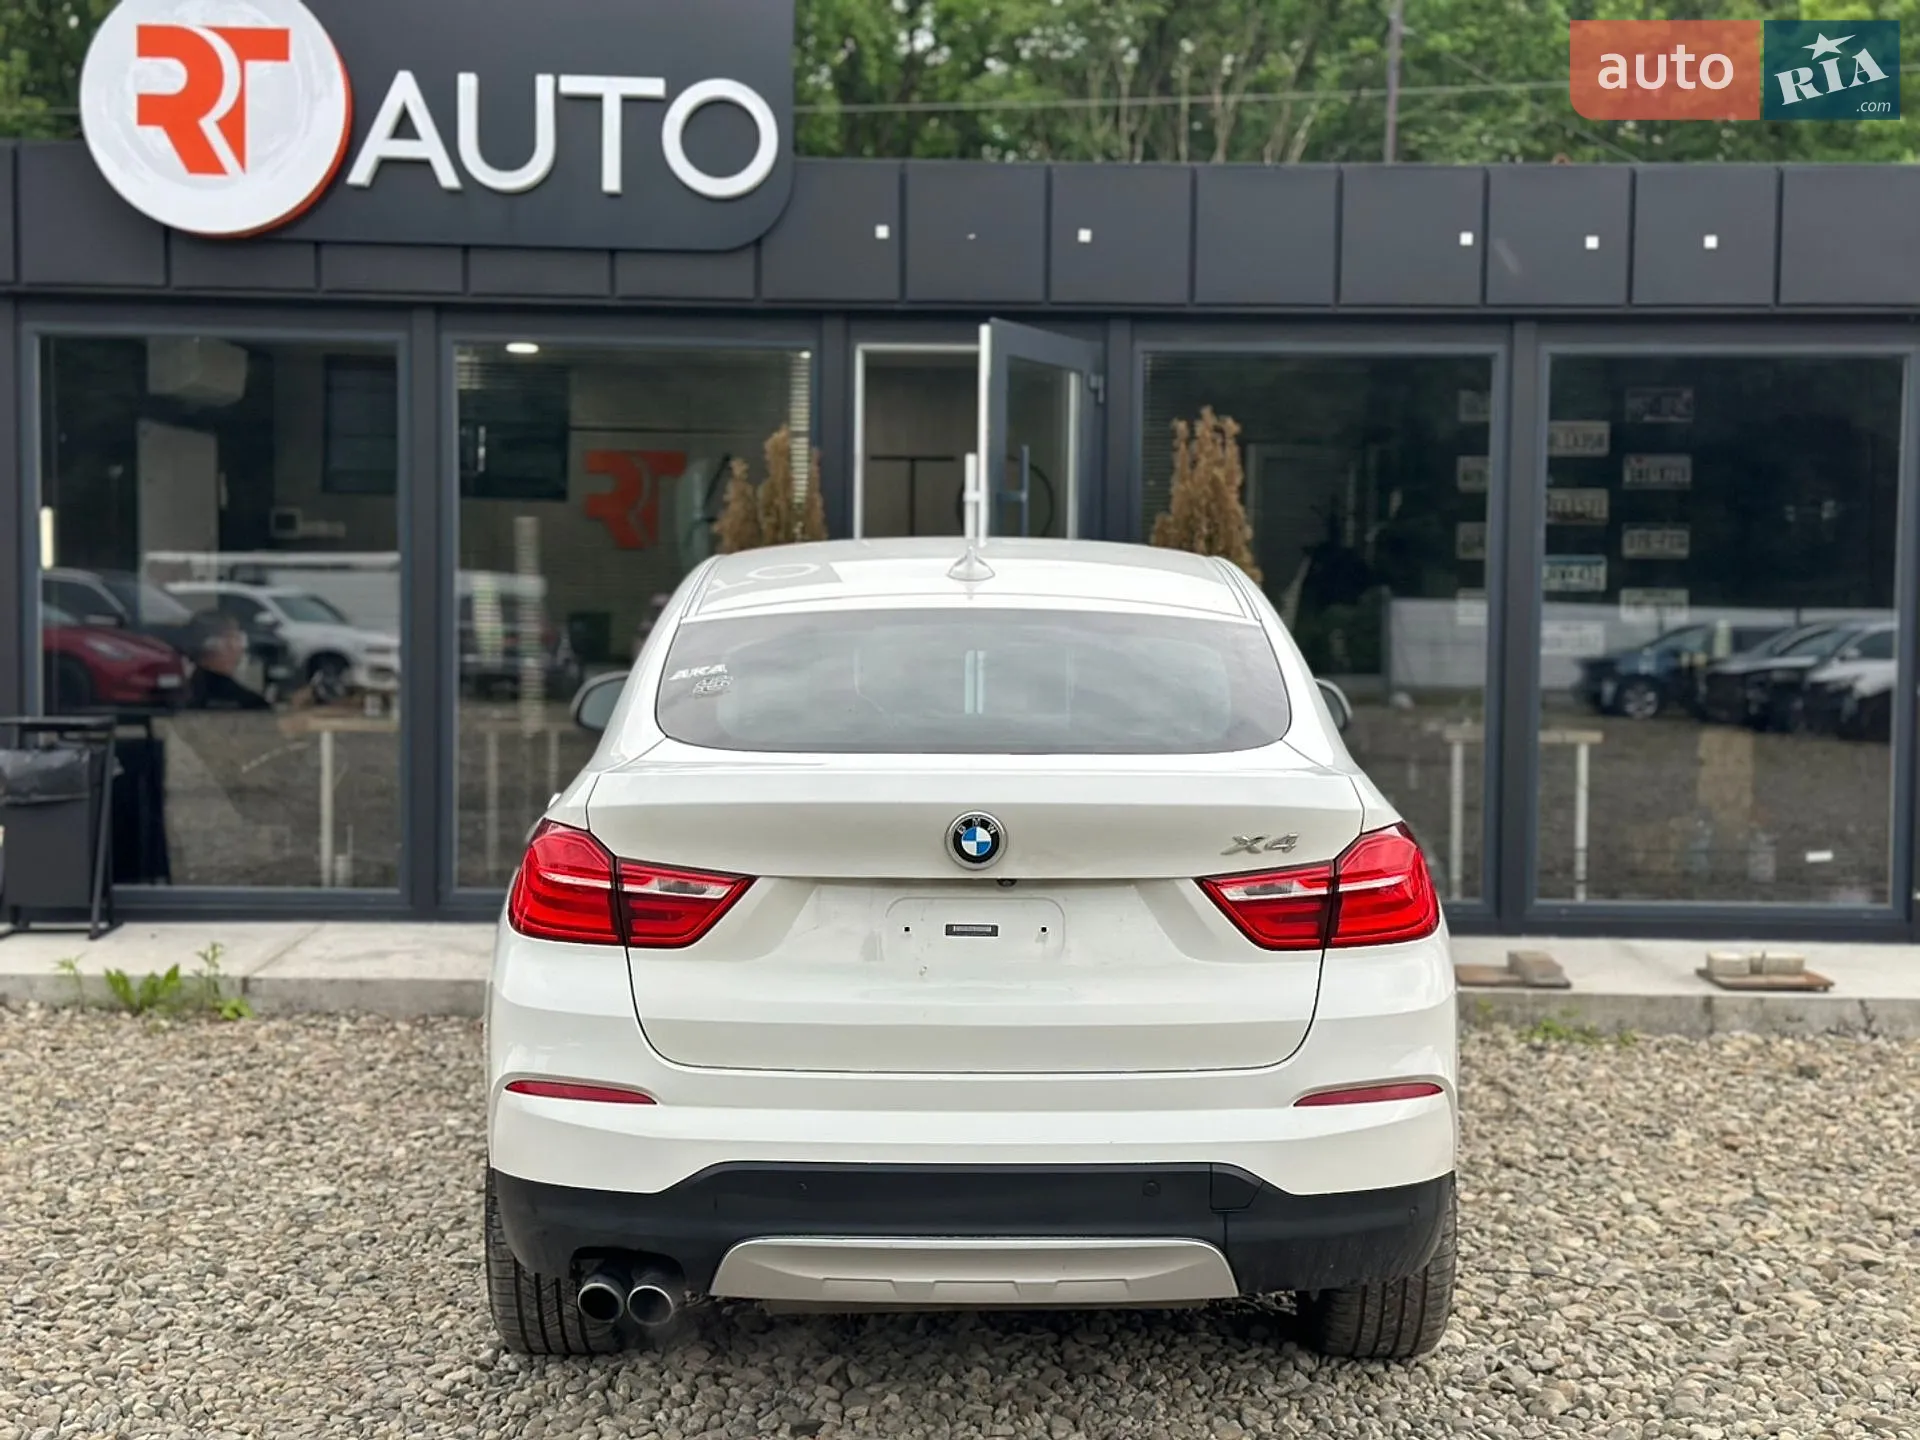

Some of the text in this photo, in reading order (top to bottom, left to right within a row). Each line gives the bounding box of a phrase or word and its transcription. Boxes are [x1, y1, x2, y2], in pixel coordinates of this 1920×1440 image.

[136, 24, 779, 198] RT AUTO
[585, 449, 687, 549] RT
[957, 818, 998, 835] BMW
[1219, 832, 1299, 856] X4
